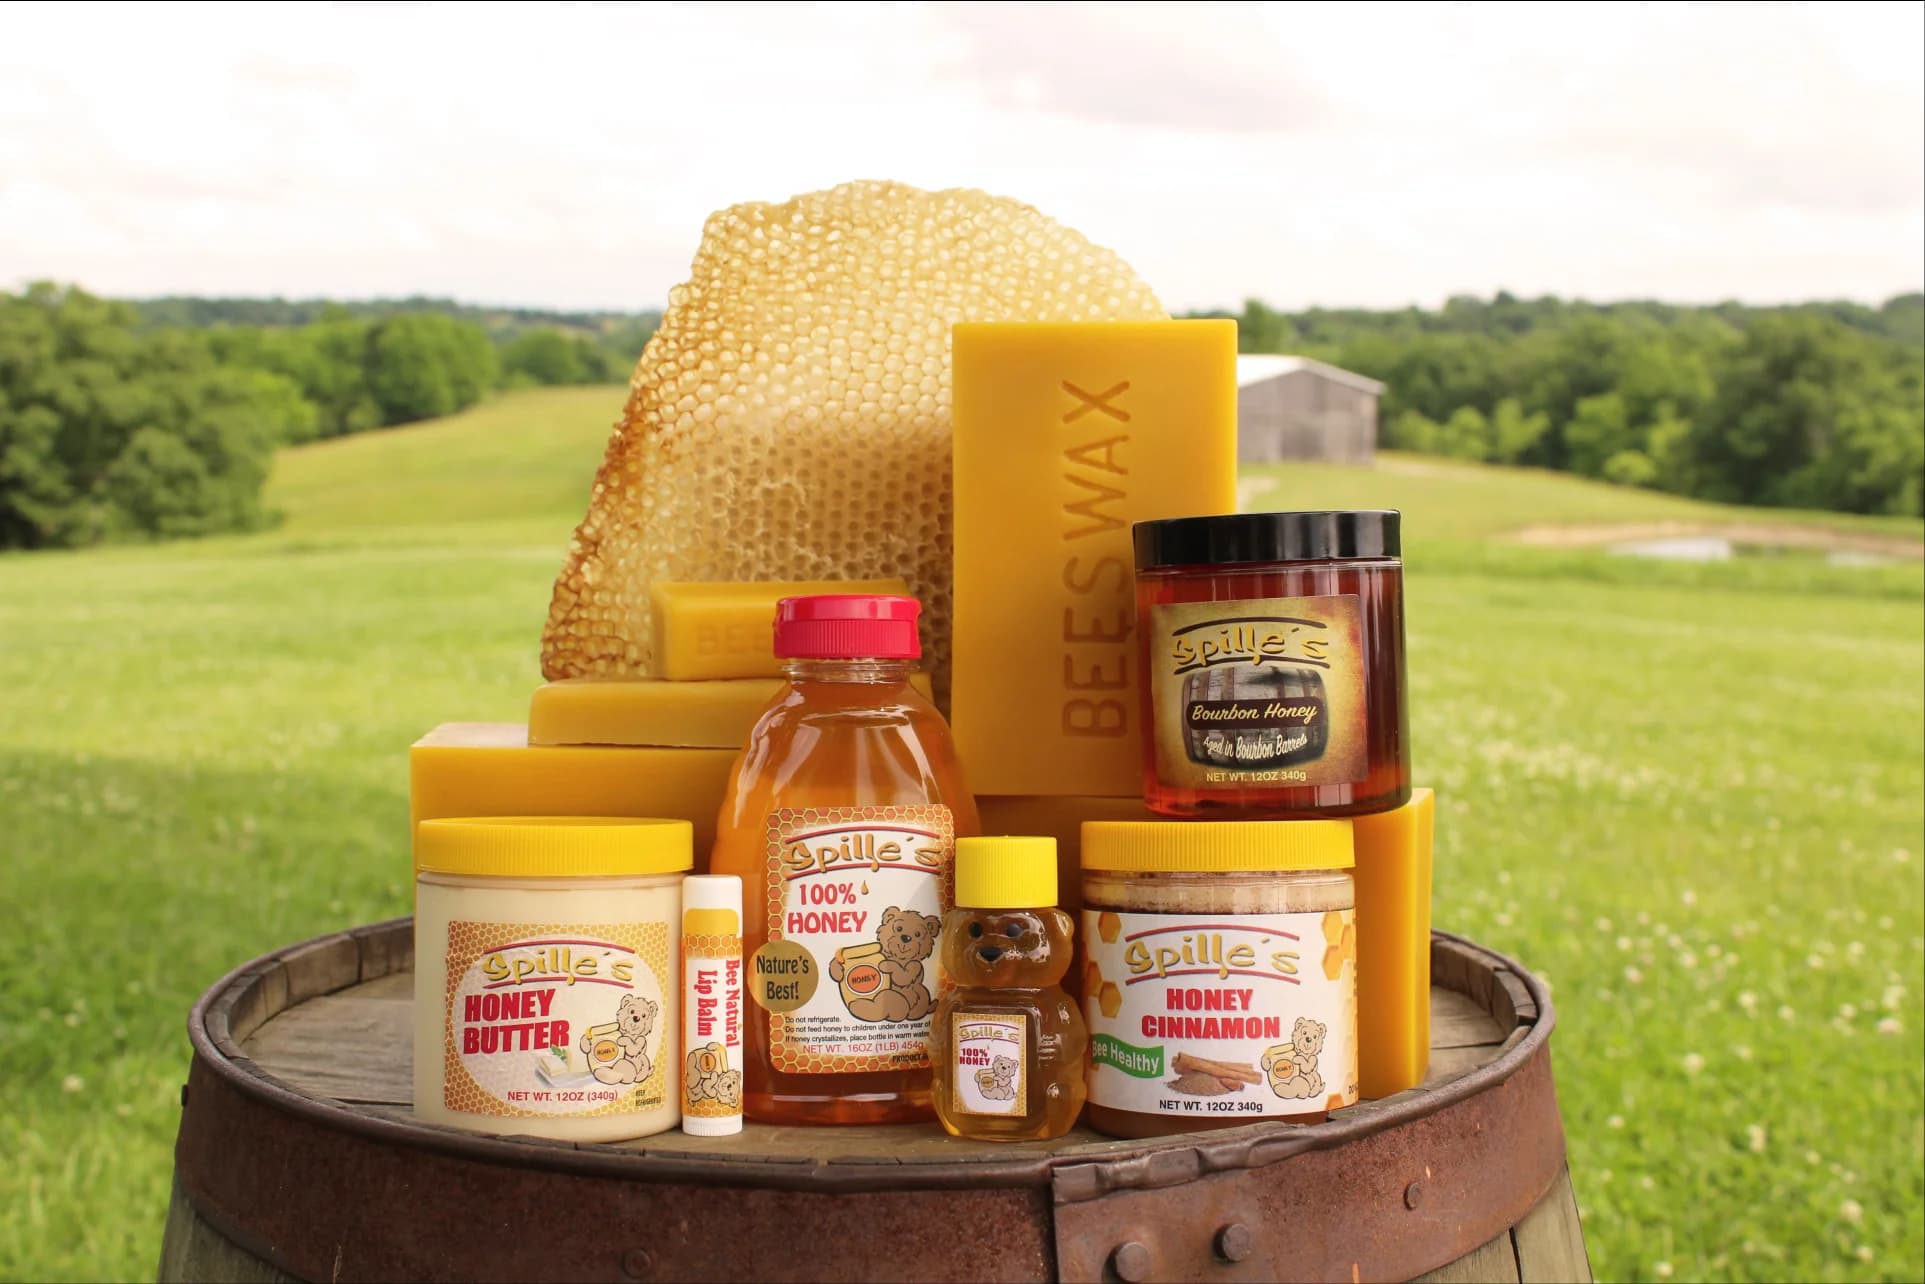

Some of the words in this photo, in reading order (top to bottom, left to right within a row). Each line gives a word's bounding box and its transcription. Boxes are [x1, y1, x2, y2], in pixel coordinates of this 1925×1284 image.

[1061, 380, 1130, 738] BEESWAX
[1192, 704, 1260, 720] Bourbon
[1264, 703, 1318, 725] Honey
[1203, 736, 1225, 755] Aged
[1225, 740, 1234, 758] in
[1235, 734, 1275, 760] Bourbon
[1276, 733, 1308, 756] Barrels
[1206, 772, 1226, 782] NET
[1228, 772, 1248, 782] WT.
[1281, 770, 1307, 782] 340g
[800, 883, 857, 905] 100%
[787, 911, 868, 934] HONEY
[482, 947, 634, 985] Spille's
[756, 955, 809, 976] Nature's
[1124, 933, 1300, 980] Spille's
[693, 970, 718, 995] Lip
[725, 960, 740, 985] Bee
[766, 980, 800, 1001] Best!
[1166, 988, 1254, 1011] HONEY
[464, 988, 556, 1023] HONEY
[697, 996, 718, 1037] Balm
[725, 987, 740, 1047] Natural
[463, 1019, 570, 1054] BUTTER
[785, 1035, 790, 1043] If
[791, 1035, 810, 1043] honey
[849, 1034, 867, 1043] place
[894, 1031, 912, 1039] warm
[807, 1025, 822, 1033] feed
[823, 1025, 842, 1033] honey
[851, 1023, 876, 1032] children
[910, 1022, 923, 1030] year
[1141, 1015, 1280, 1039] CINNAMON
[803, 1045, 823, 1054] NET
[875, 1041, 899, 1053] (1LB)
[901, 1040, 924, 1050] 454g
[962, 1048, 988, 1057] 100%
[1092, 1041, 1108, 1057] Bee
[1110, 1042, 1160, 1075] Healthy
[960, 1056, 990, 1066] HONEY
[507, 1091, 529, 1101] NET
[533, 1092, 552, 1101] WT.
[587, 1090, 618, 1103] (340g)
[1159, 1099, 1181, 1110] NET
[1183, 1101, 1202, 1111] WT.
[1237, 1101, 1263, 1113] 340g
